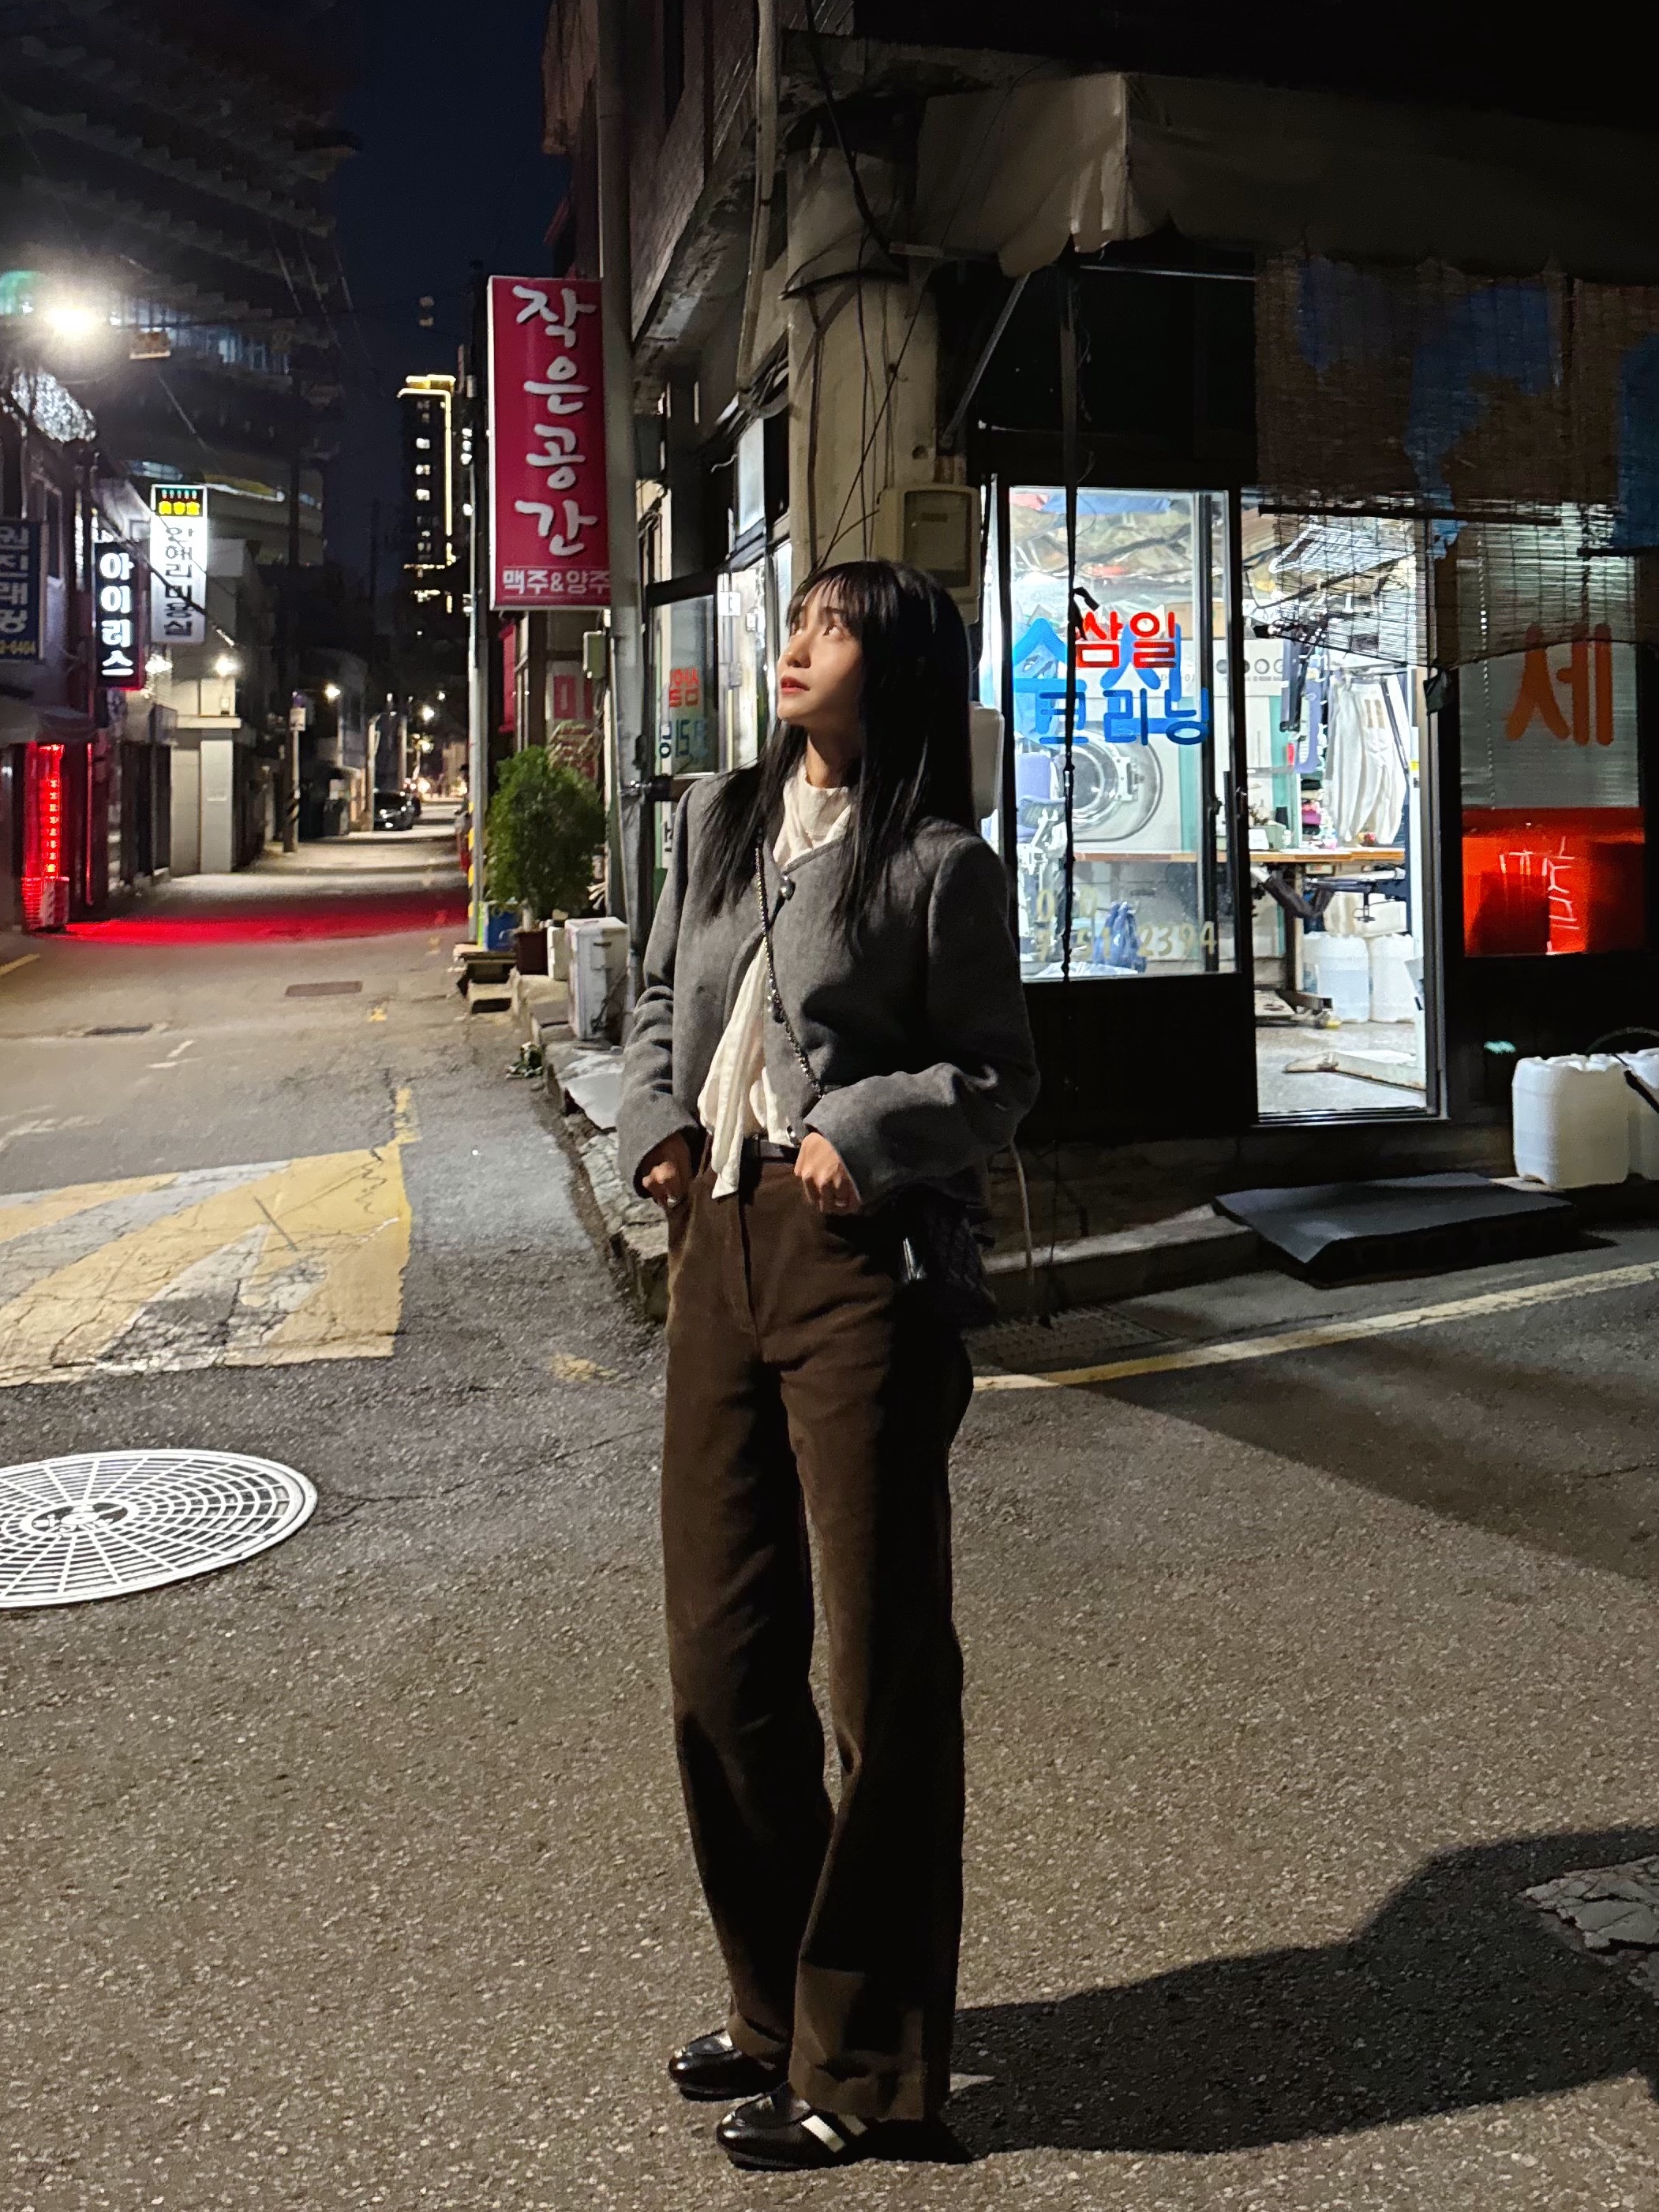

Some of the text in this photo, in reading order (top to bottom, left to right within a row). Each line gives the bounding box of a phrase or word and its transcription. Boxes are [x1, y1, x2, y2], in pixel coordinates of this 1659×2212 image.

[512, 285, 597, 556] 작은공간
[503, 570, 611, 595] 맥주&양주
[99, 552, 135, 676] 아이리스
[1075, 611, 1177, 668] 삼일
[1039, 687, 1210, 745] 크리닝
